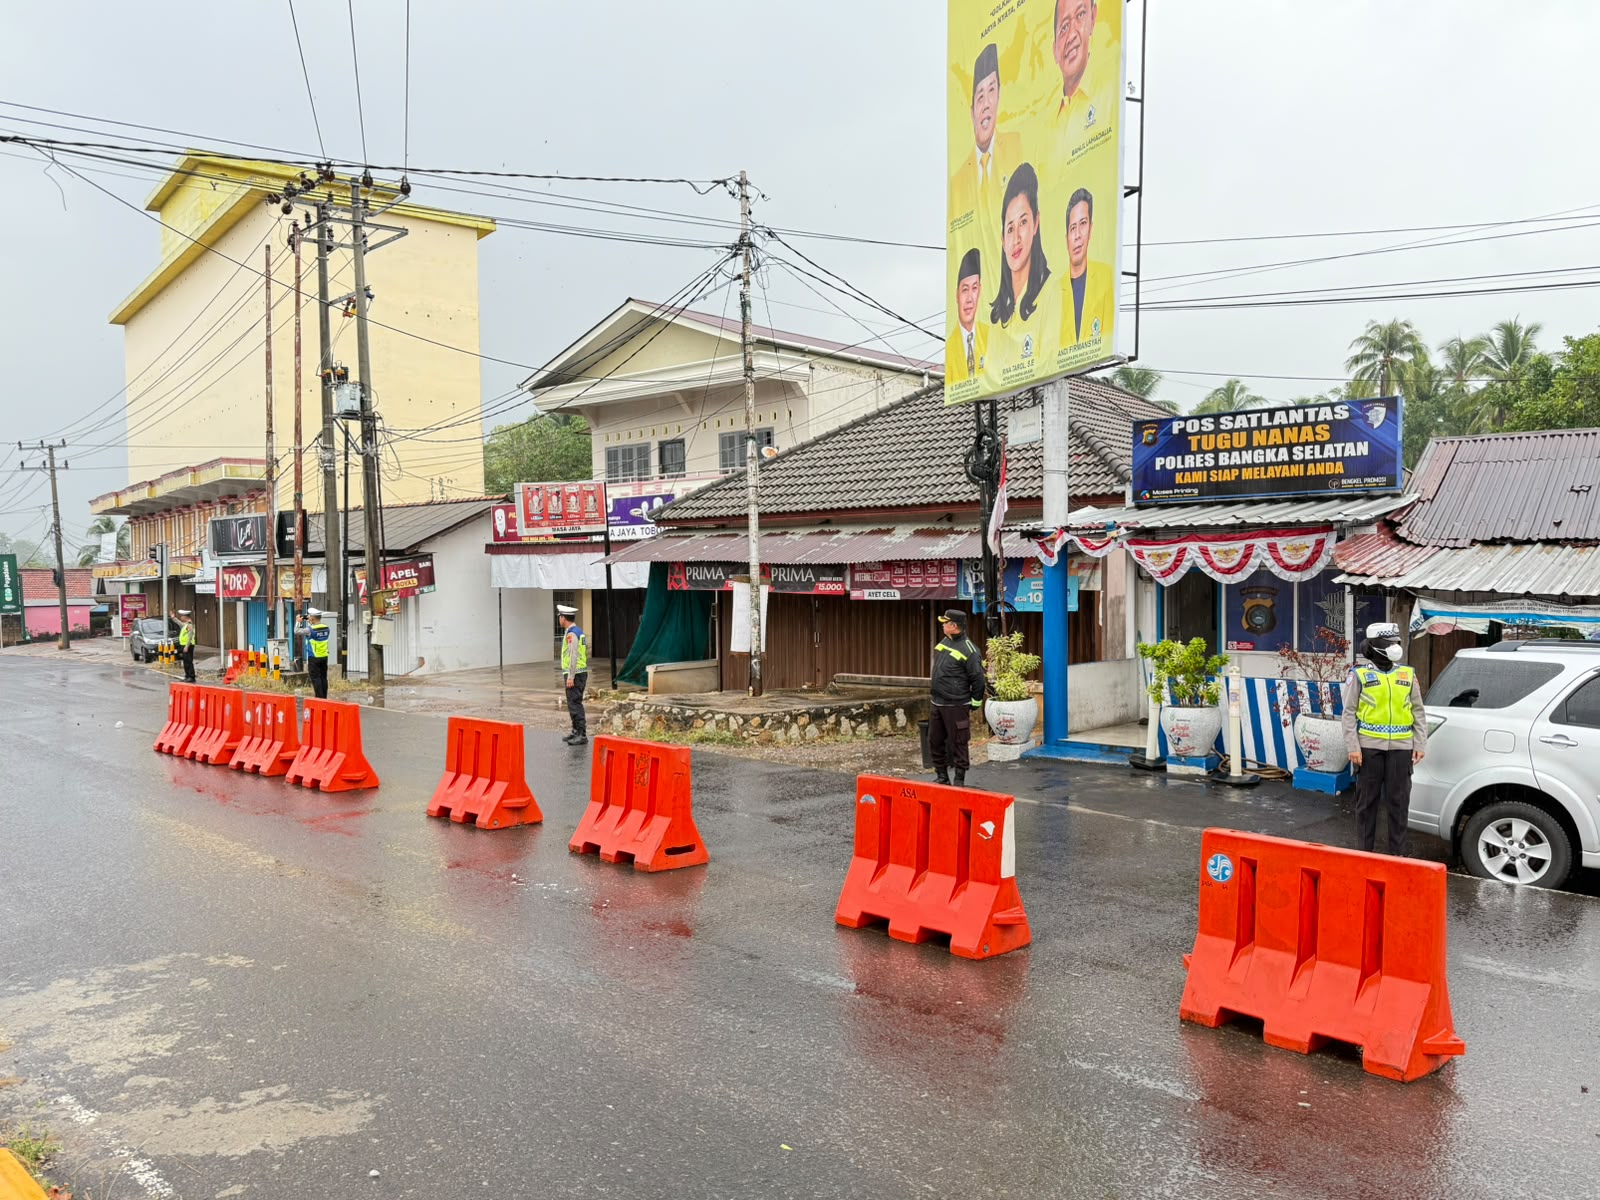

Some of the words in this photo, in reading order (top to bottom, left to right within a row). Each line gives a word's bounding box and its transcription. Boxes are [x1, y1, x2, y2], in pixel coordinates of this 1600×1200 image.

[1172, 417, 1215, 434] POS
[1219, 404, 1350, 430] SATLANTAS
[1187, 431, 1247, 452] TUGU
[1252, 423, 1331, 447] NANAS
[1155, 453, 1215, 470] POLRES
[1218, 447, 1289, 466] BANGKA
[1292, 441, 1369, 461] SELATAN
[1175, 471, 1207, 484] KAMI
[1209, 468, 1240, 482] SIAP
[1241, 463, 1304, 480] MELAYANI
[1306, 461, 1345, 476] ANDA
[1174, 487, 1199, 495] Printing
[617, 527, 637, 537] JAYA
[390, 568, 418, 580] APEL
[686, 566, 725, 580] PRIMA
[771, 567, 816, 583] PRIMA
[395, 579, 417, 588] ROYAL
[900, 787, 916, 799] ASA
